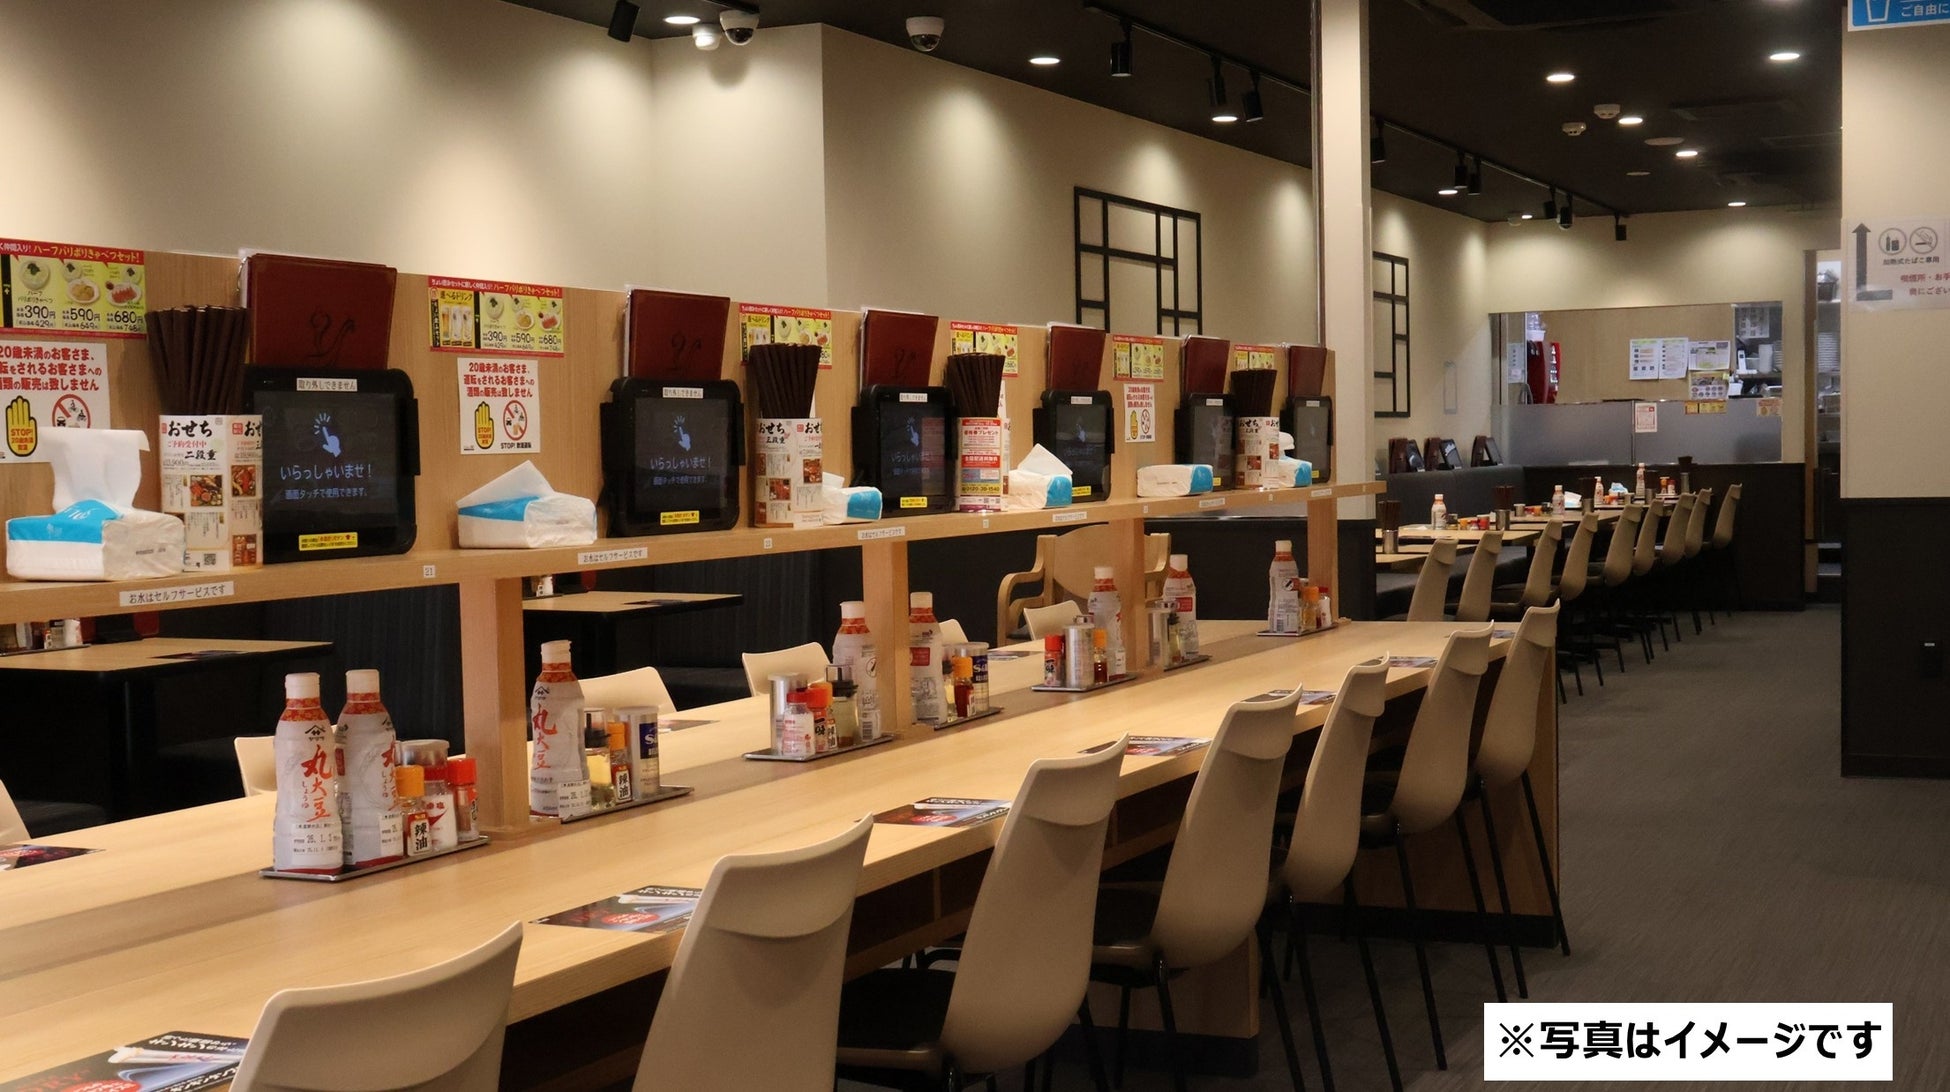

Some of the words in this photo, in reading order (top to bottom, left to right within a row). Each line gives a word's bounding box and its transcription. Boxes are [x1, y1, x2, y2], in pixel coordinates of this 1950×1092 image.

[1901, 3, 1949, 17] ご自由に
[0, 377, 99, 392] 類の販売は致しません
[168, 420, 213, 438] おせち
[759, 422, 785, 434] おせち
[184, 449, 217, 461] 二段重
[280, 463, 373, 481] いらっしゃいませ！
[129, 584, 226, 604] お水はセルフサービスです
[301, 744, 332, 823] 丸大豆
[414, 822, 428, 851] 辣油
